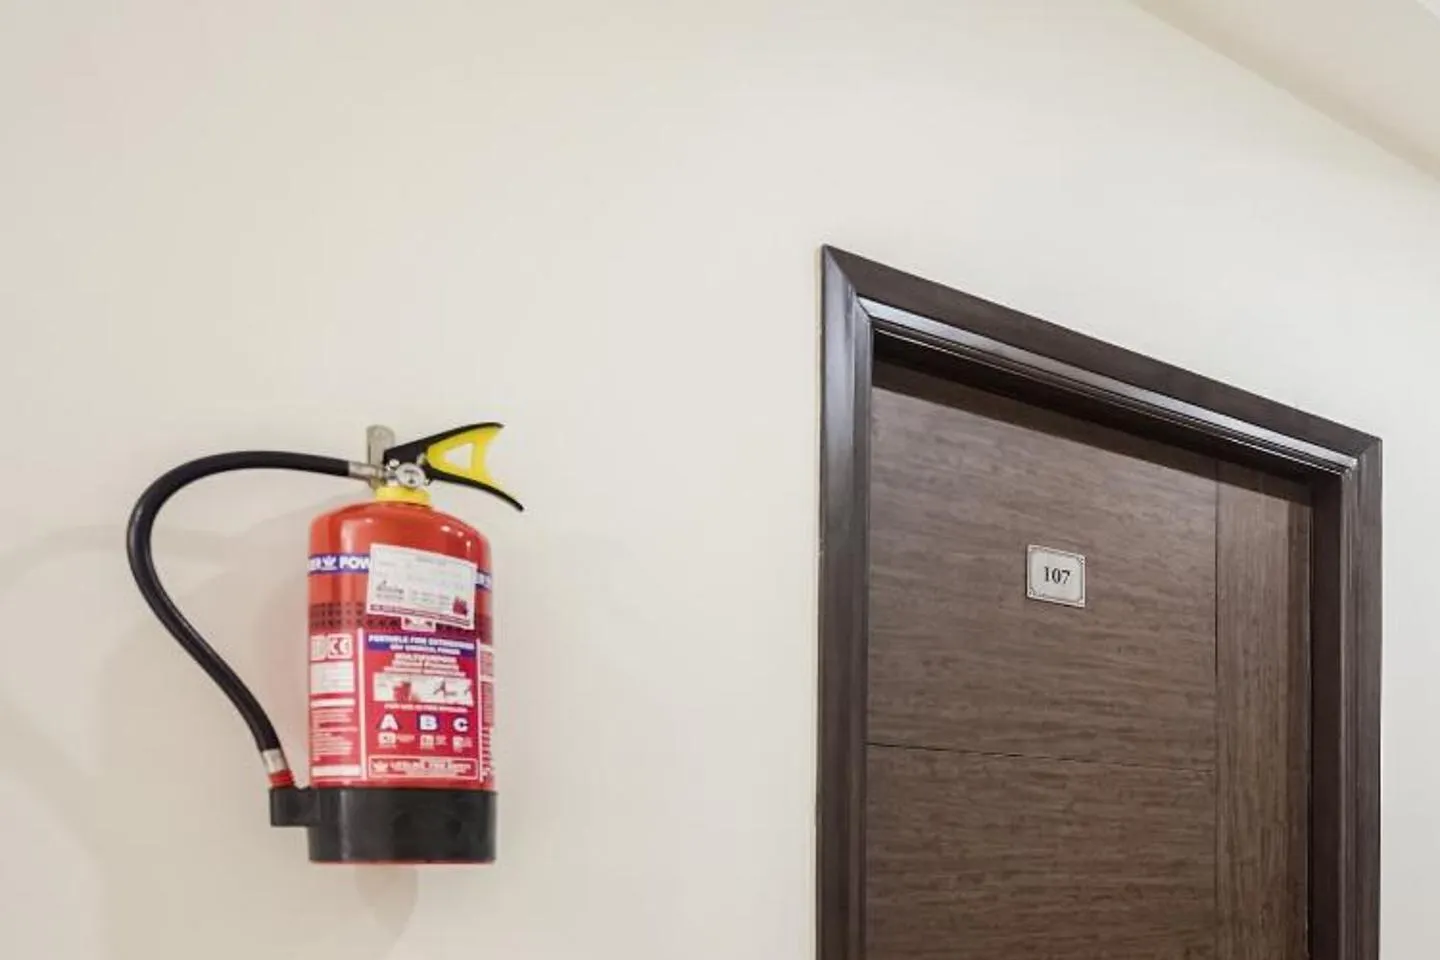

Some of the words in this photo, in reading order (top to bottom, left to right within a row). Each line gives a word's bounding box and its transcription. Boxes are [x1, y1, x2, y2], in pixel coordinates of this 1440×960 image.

[1044, 566, 1070, 584] 107
[380, 713, 398, 730] A
[420, 714, 437, 731] B
[453, 717, 468, 732] C
